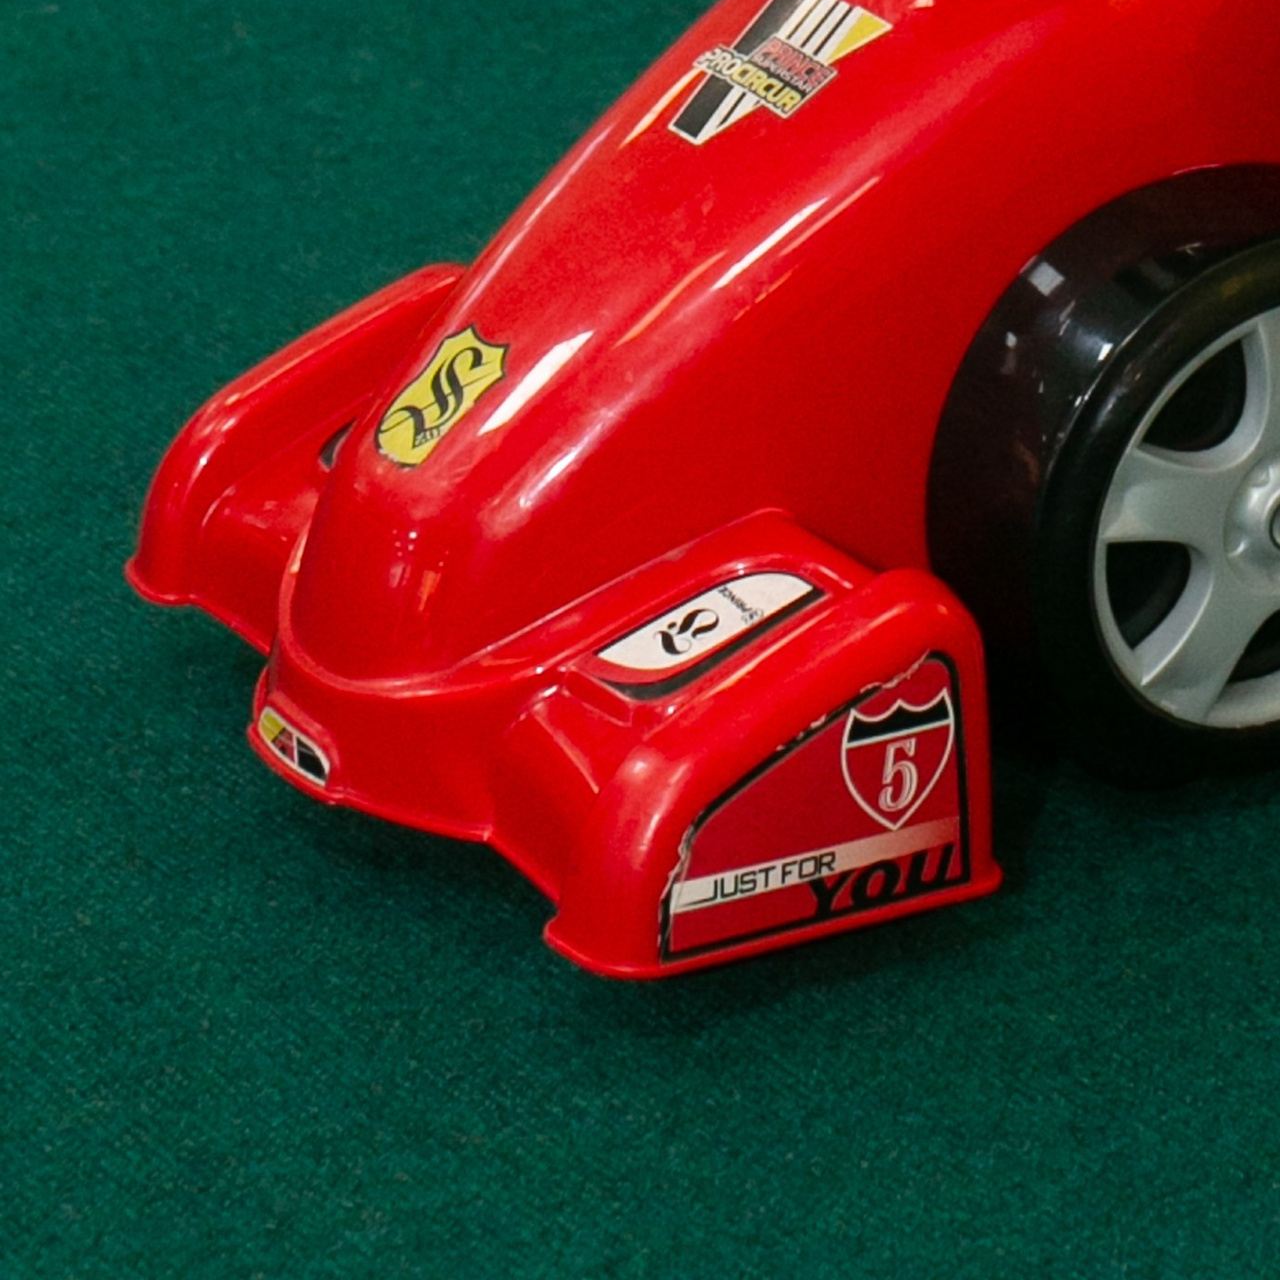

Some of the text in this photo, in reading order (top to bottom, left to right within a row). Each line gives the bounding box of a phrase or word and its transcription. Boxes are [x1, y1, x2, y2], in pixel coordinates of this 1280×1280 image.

[759, 39, 833, 88] PRINCE
[878, 737, 918, 812] 5
[683, 866, 777, 909] JUST
[781, 851, 837, 885] FOR
